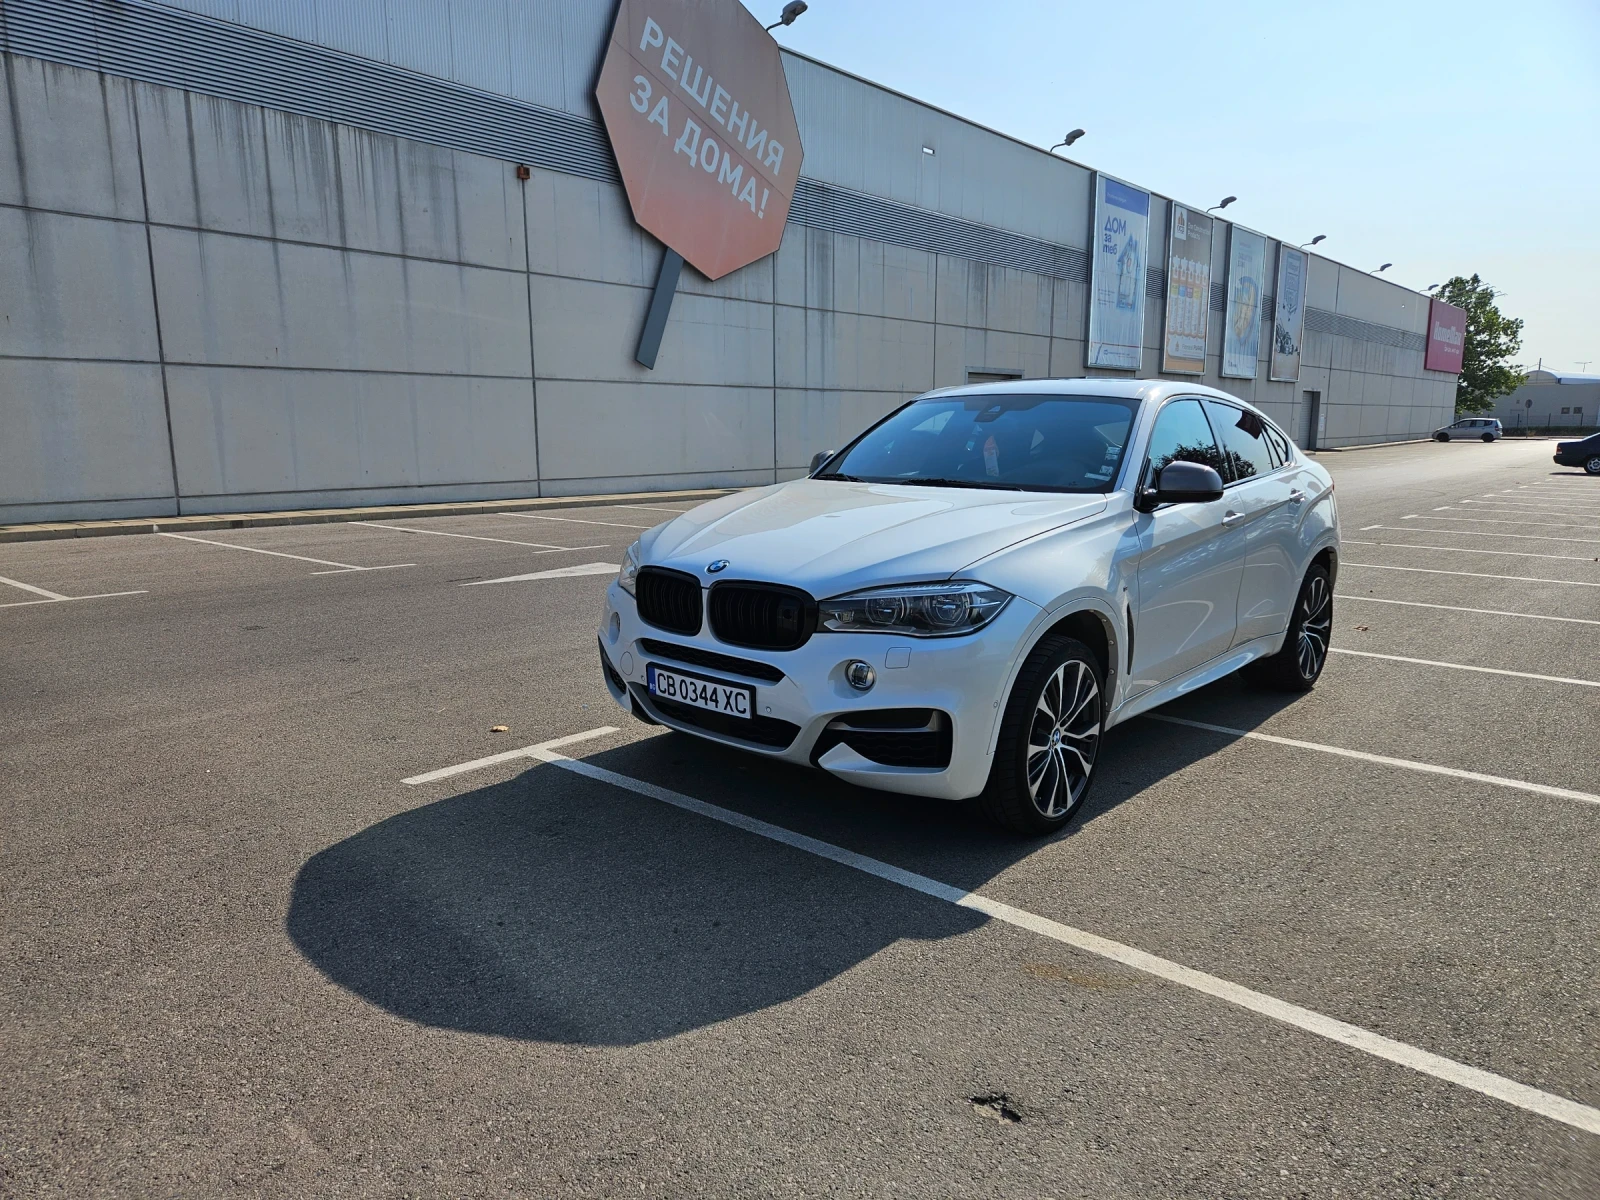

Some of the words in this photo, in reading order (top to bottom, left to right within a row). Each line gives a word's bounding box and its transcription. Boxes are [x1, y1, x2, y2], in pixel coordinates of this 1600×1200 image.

[639, 16, 785, 176] РЕШЕНИЯ
[629, 75, 669, 137] ЗА
[673, 117, 770, 219] ДОМА!
[1104, 215, 1127, 236] ДОМ
[657, 672, 677, 697] CB
[679, 679, 720, 709] 0344
[722, 688, 747, 714] XC
